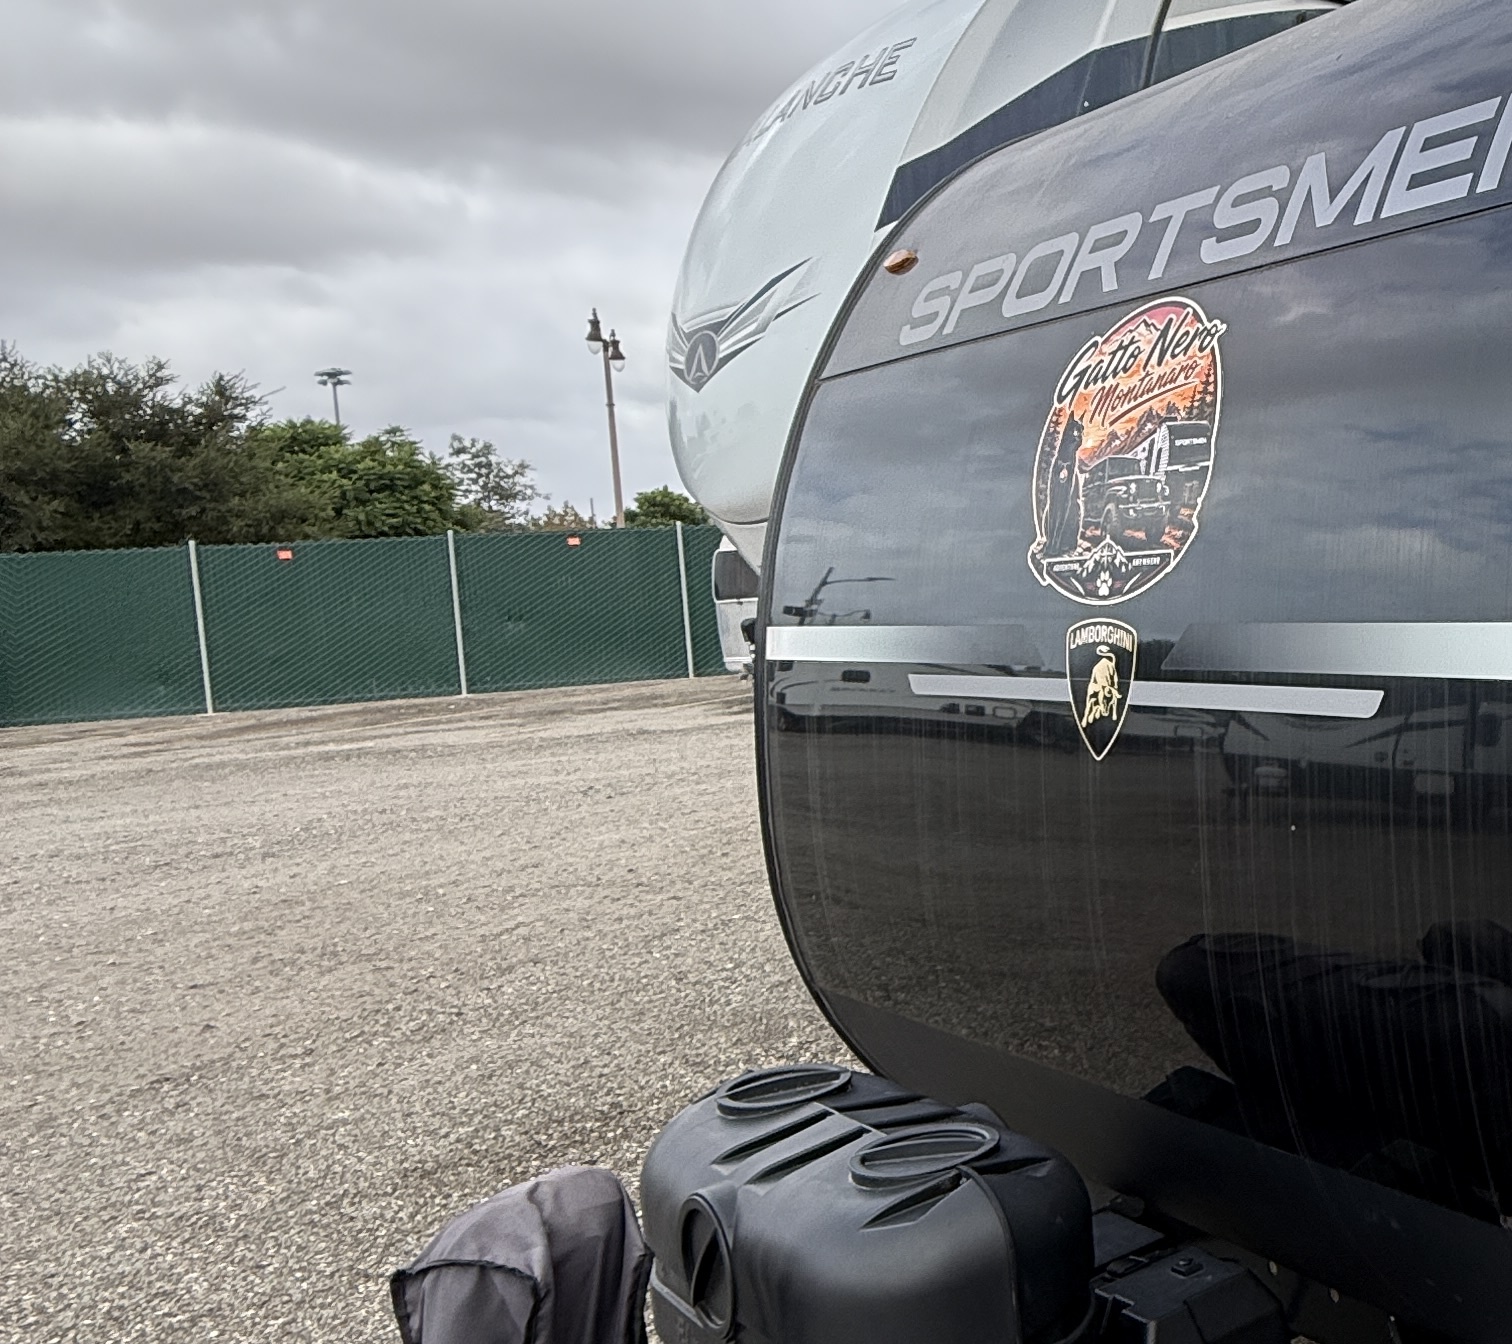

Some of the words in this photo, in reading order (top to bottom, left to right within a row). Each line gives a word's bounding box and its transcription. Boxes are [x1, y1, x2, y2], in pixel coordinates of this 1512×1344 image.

[1056, 335, 1145, 411] Gatto
[1142, 311, 1224, 372] Nero
[1088, 360, 1200, 428] Montanaro
[1069, 624, 1133, 653] LAMBORGHINI
